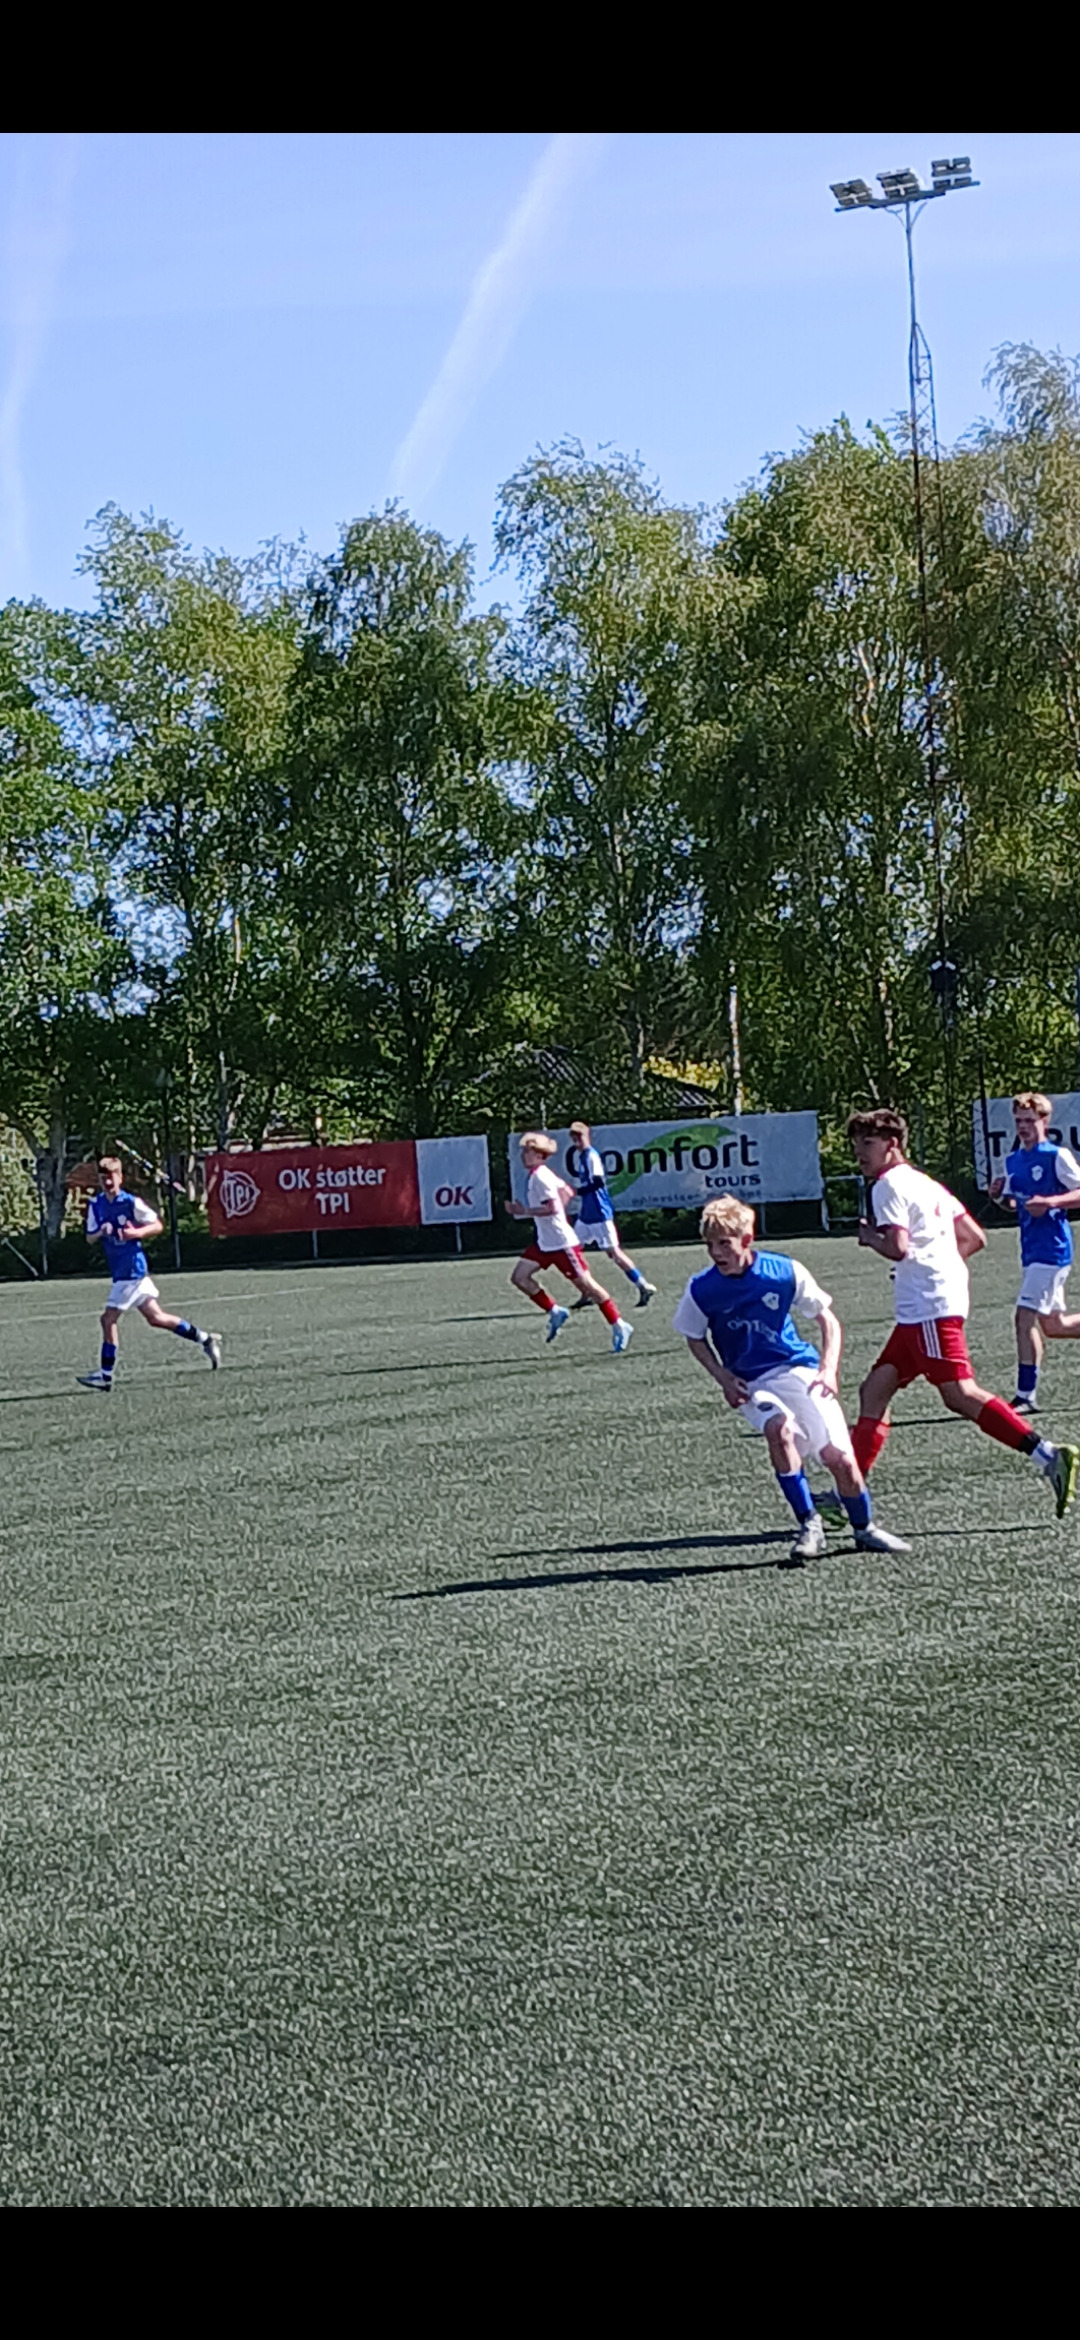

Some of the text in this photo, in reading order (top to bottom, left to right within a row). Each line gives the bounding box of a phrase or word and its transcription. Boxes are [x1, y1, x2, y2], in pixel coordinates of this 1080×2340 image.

[564, 1134, 760, 1178] Comfort
[279, 1165, 387, 1190] OK støtter
[705, 1174, 761, 1188] tours
[227, 1179, 251, 1207] TPI
[316, 1192, 350, 1215] TPI
[434, 1185, 475, 1208] OK
